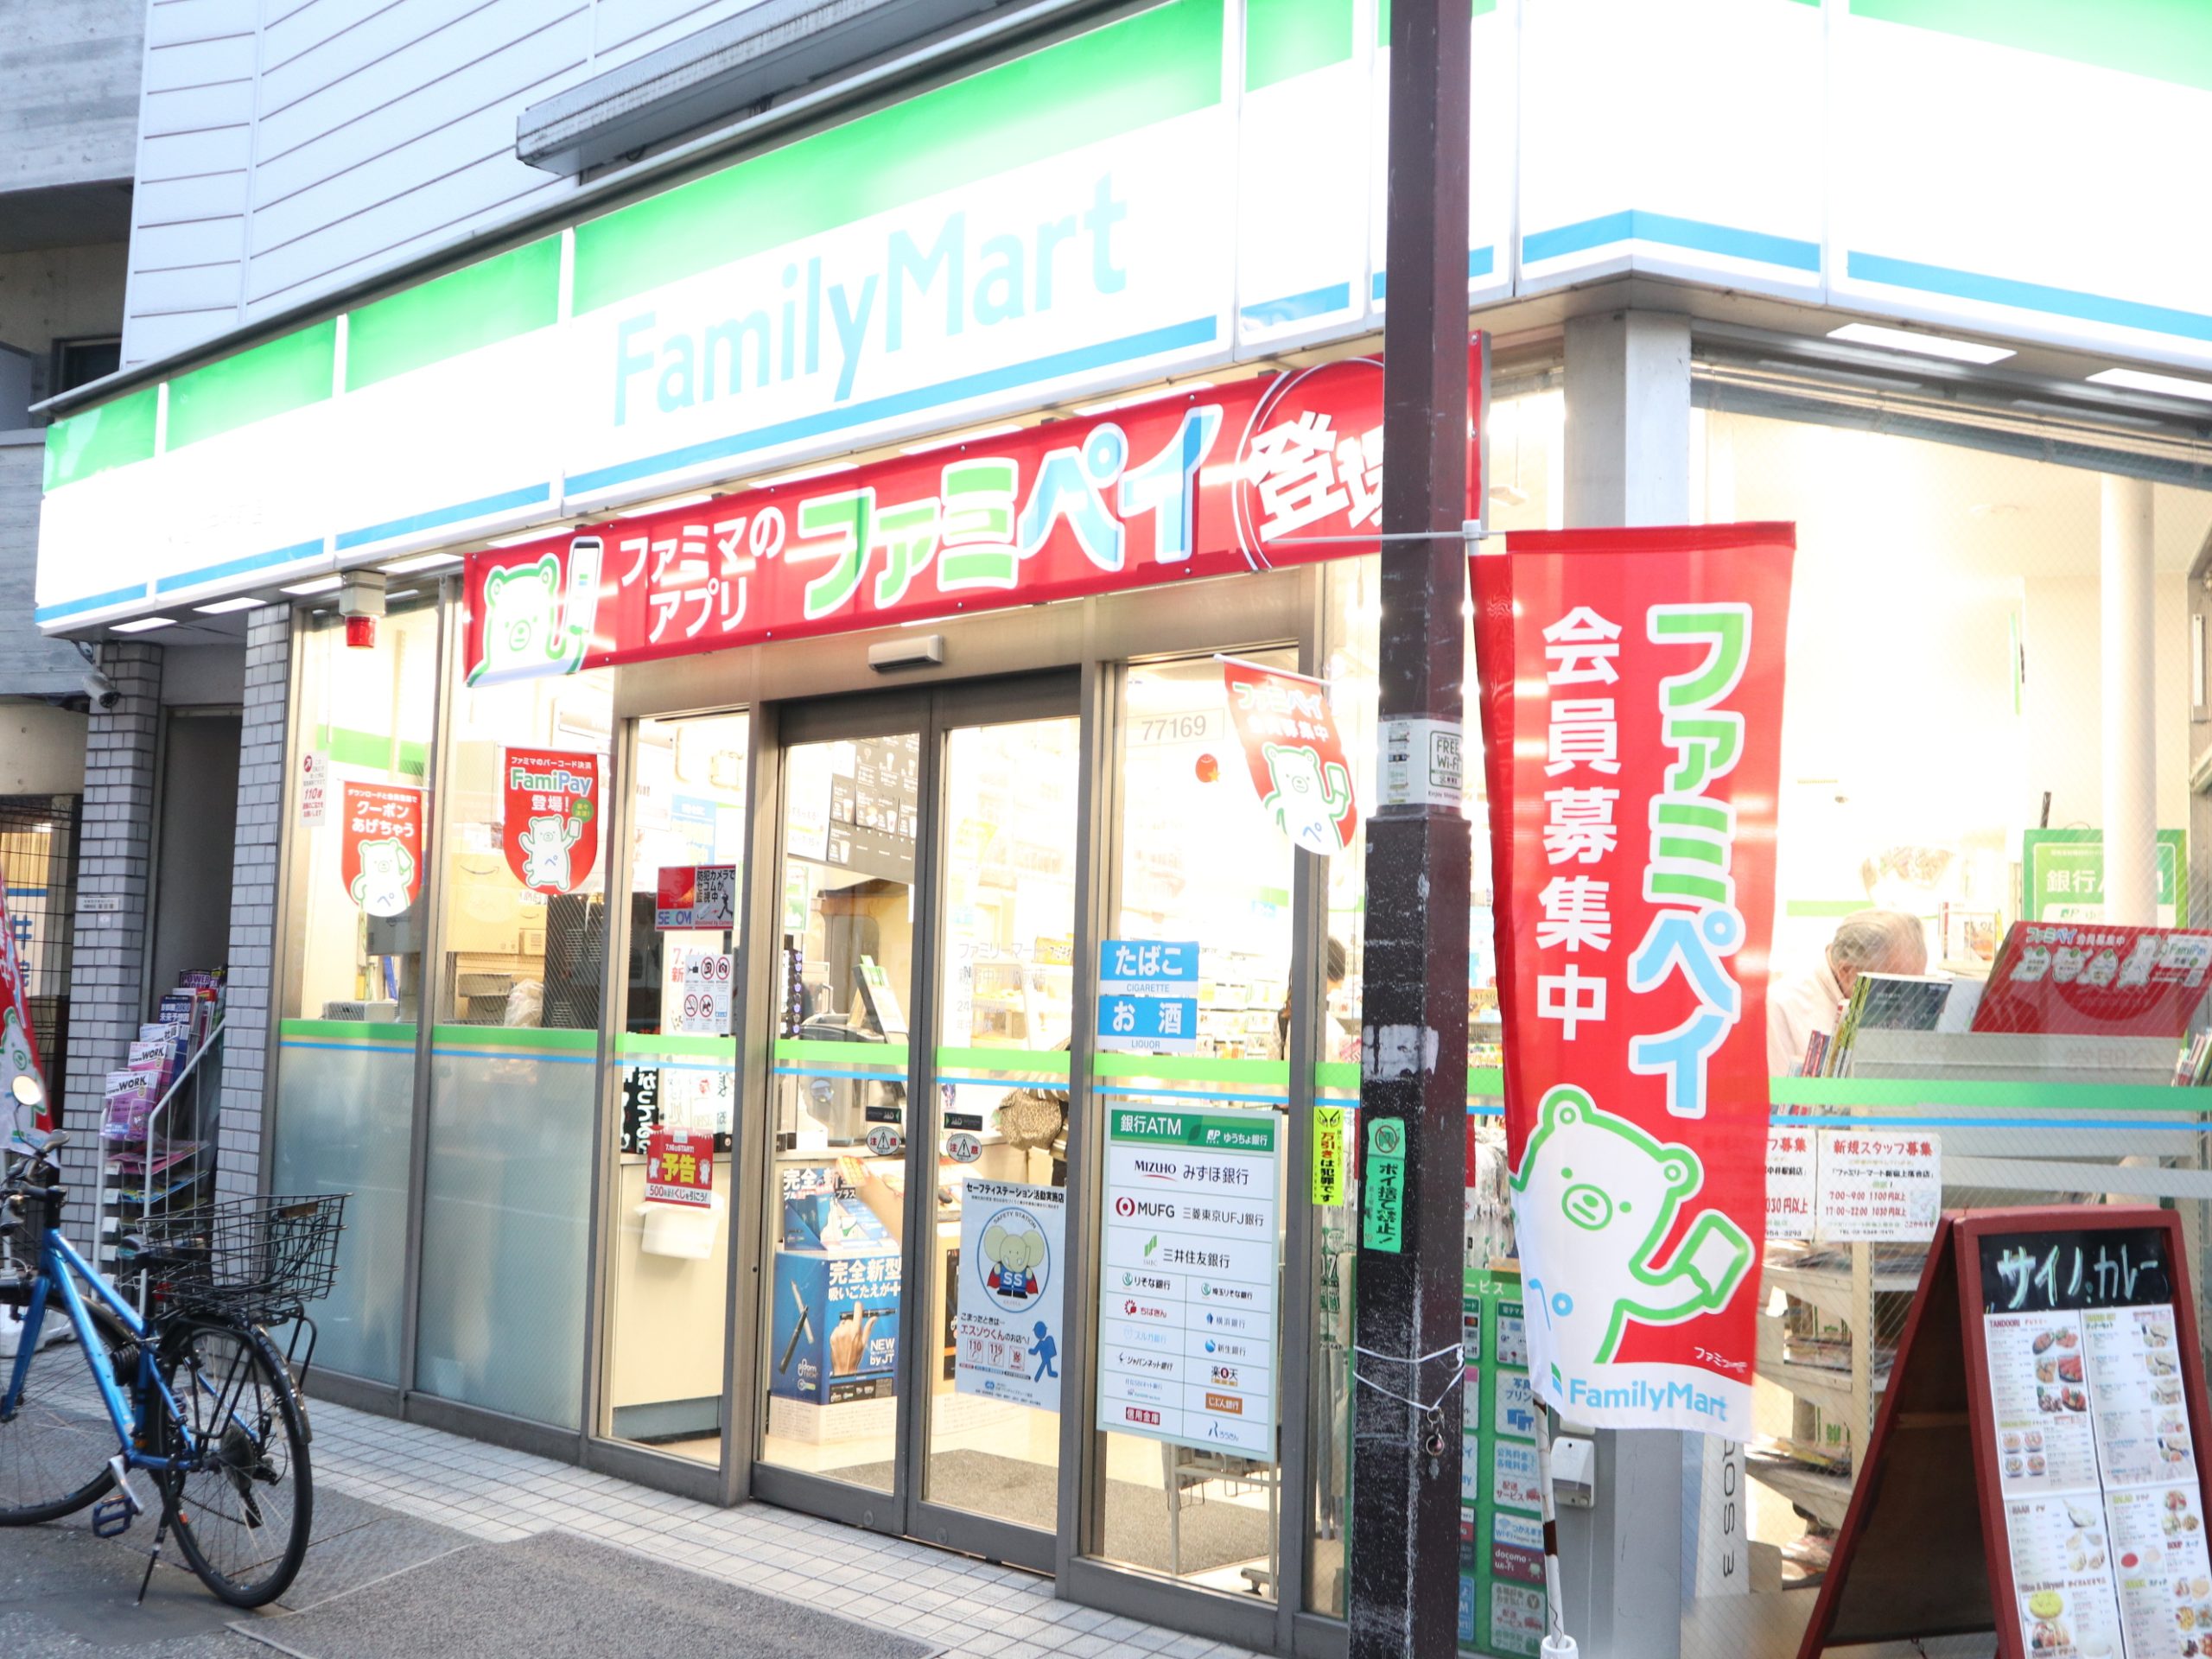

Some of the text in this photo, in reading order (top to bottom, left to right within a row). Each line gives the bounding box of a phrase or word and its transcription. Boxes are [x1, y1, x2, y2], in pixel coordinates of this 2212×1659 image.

[614, 172, 1128, 427] FamilyMart
[798, 404, 1224, 620] ファミペイ
[620, 505, 786, 588] ファミマの
[649, 575, 748, 645] アプリ
[1141, 715, 1206, 741] 77169
[1437, 740, 1459, 754] FREE
[511, 766, 593, 798] FamiPay
[357, 801, 410, 818] クーポン
[352, 817, 414, 837] あげちゃう
[1536, 606, 1622, 1040] 会員募集中
[1627, 602, 1752, 1120] ファミペイ
[1115, 945, 1182, 976] たばこ
[1127, 982, 1170, 993] CIGARETTE
[142, 1046, 165, 1061] WORK
[1131, 1039, 1160, 1050] LIQUOR
[118, 1076, 147, 1091] WORK
[1121, 1115, 1182, 1135] 銀行ATM
[1224, 1133, 1268, 1147] ゆうちょ銀行
[1834, 1140, 1932, 1156] 新規スタッフ募集
[661, 1153, 696, 1185] 予告
[1135, 1160, 1249, 1185] MIZUHO みずほ銀行
[966, 1182, 1065, 1204] セーフティステーション活動実施店
[993, 1211, 1037, 1229] SAFETY STATION
[1137, 1202, 1264, 1227] MUFG 三菱東京UFJ銀行
[1163, 1248, 1230, 1268] 三井住友銀行
[829, 1257, 902, 1286] 完全新型
[1003, 1271, 1024, 1287] SS
[1135, 1277, 1170, 1290] りそな銀行
[1463, 1279, 1504, 1295] ービス
[870, 1338, 895, 1351] NEW
[969, 1341, 1003, 1354] 110 119
[870, 1354, 894, 1365] by JT
[1569, 1378, 1728, 1422] FamilyMart
[1127, 1408, 1160, 1424] 信用金庫
[1495, 1549, 1526, 1563] docomo
